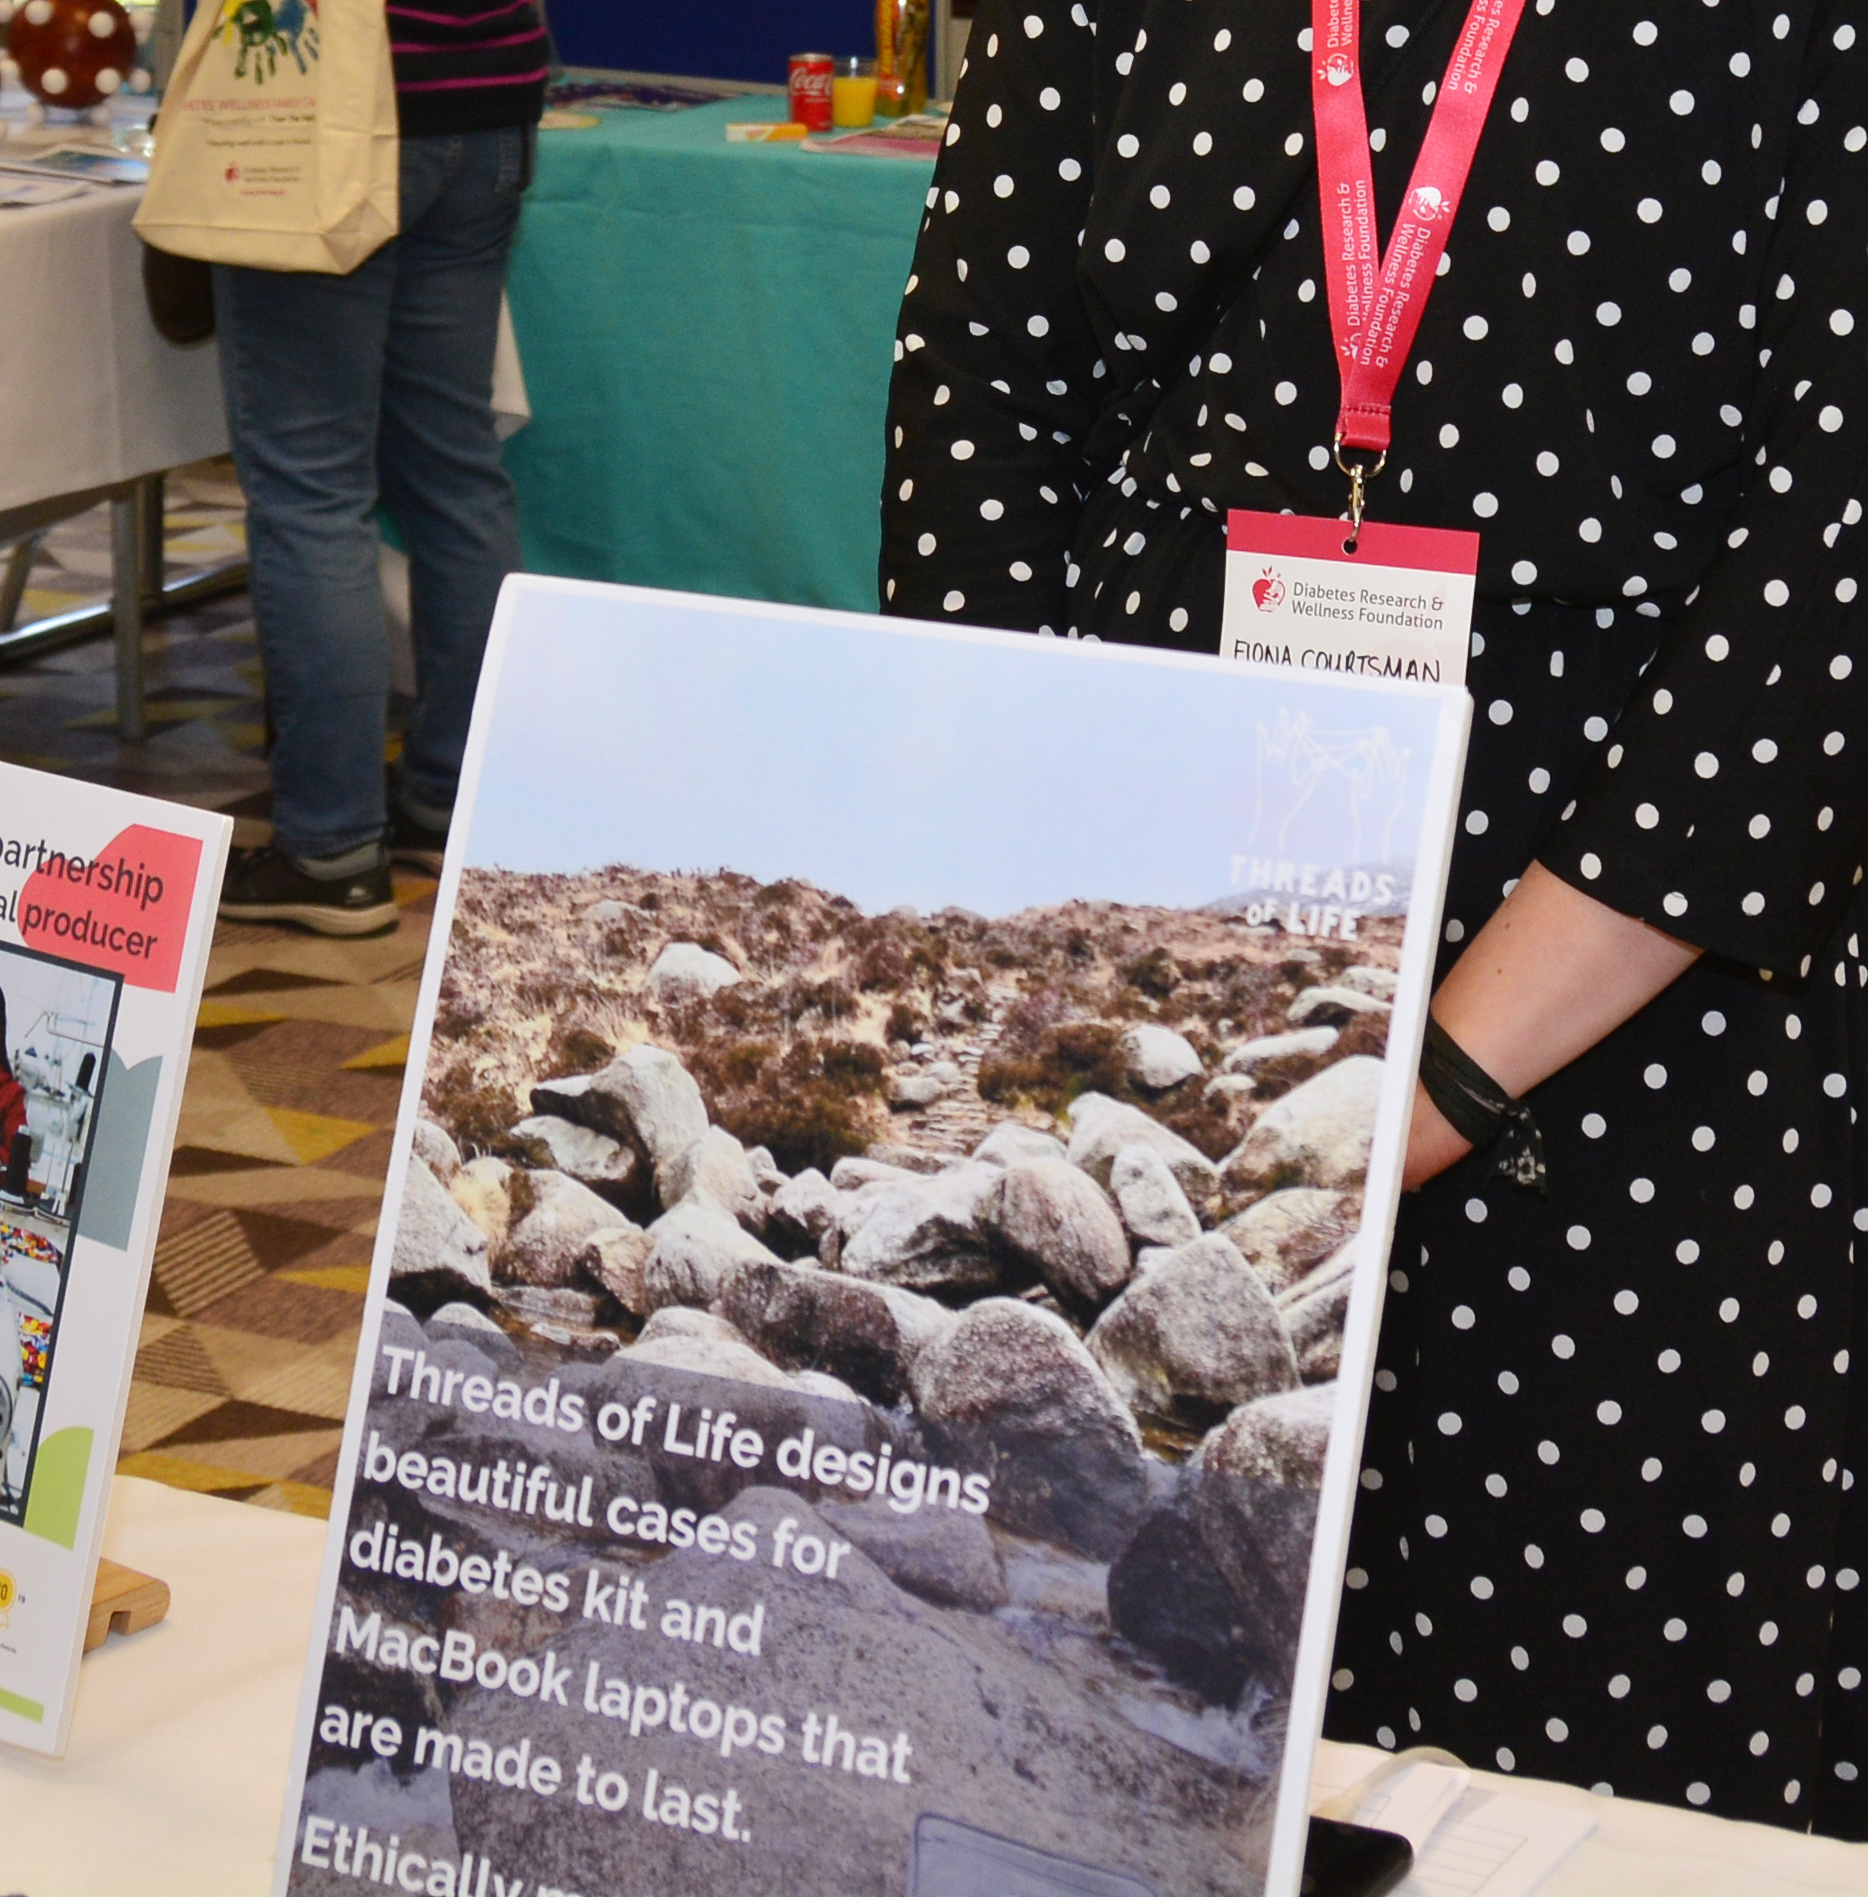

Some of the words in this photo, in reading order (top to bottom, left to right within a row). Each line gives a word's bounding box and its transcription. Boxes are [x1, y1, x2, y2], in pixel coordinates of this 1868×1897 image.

[1448, 14, 1485, 90] Foundation
[1469, 17, 1500, 79] Research
[1464, 81, 1477, 95] &
[1337, 183, 1350, 195] &
[1355, 179, 1371, 260] Foundation
[1338, 203, 1356, 261] Research
[1384, 223, 1416, 285] Wellness
[1400, 226, 1431, 289] Diabetes
[1345, 264, 1360, 326] Diabetes
[1380, 289, 1410, 354] Research
[1360, 287, 1394, 366] Foundation
[1375, 356, 1389, 368] &
[1292, 600, 1354, 621] Wellness
[1358, 607, 1443, 630] Foundation
[1293, 582, 1356, 602] Diabetes
[1360, 589, 1427, 610] Research
[1431, 597, 1444, 612] &
[1234, 639, 1292, 668] FIONA
[1300, 649, 1442, 684] COURTSMAN
[1228, 854, 1398, 907] THREADS
[22, 903, 158, 960] producer
[1286, 902, 1363, 942] LIFE
[382, 1346, 584, 1434] Threads
[597, 1396, 655, 1446] of
[663, 1404, 765, 1470] Life
[775, 1429, 991, 1516] designs
[364, 1432, 593, 1528] beautiful
[606, 1496, 757, 1562] cases
[772, 1517, 852, 1580] for
[349, 1521, 569, 1614] diabetes
[583, 1568, 648, 1631] kit
[661, 1597, 765, 1657] and
[335, 1605, 572, 1706] MacBook
[584, 1661, 786, 1757] laptops
[802, 1712, 914, 1785] that
[319, 1703, 403, 1758] are
[413, 1727, 562, 1797] made
[576, 1754, 629, 1812] to
[643, 1767, 752, 1843] last.
